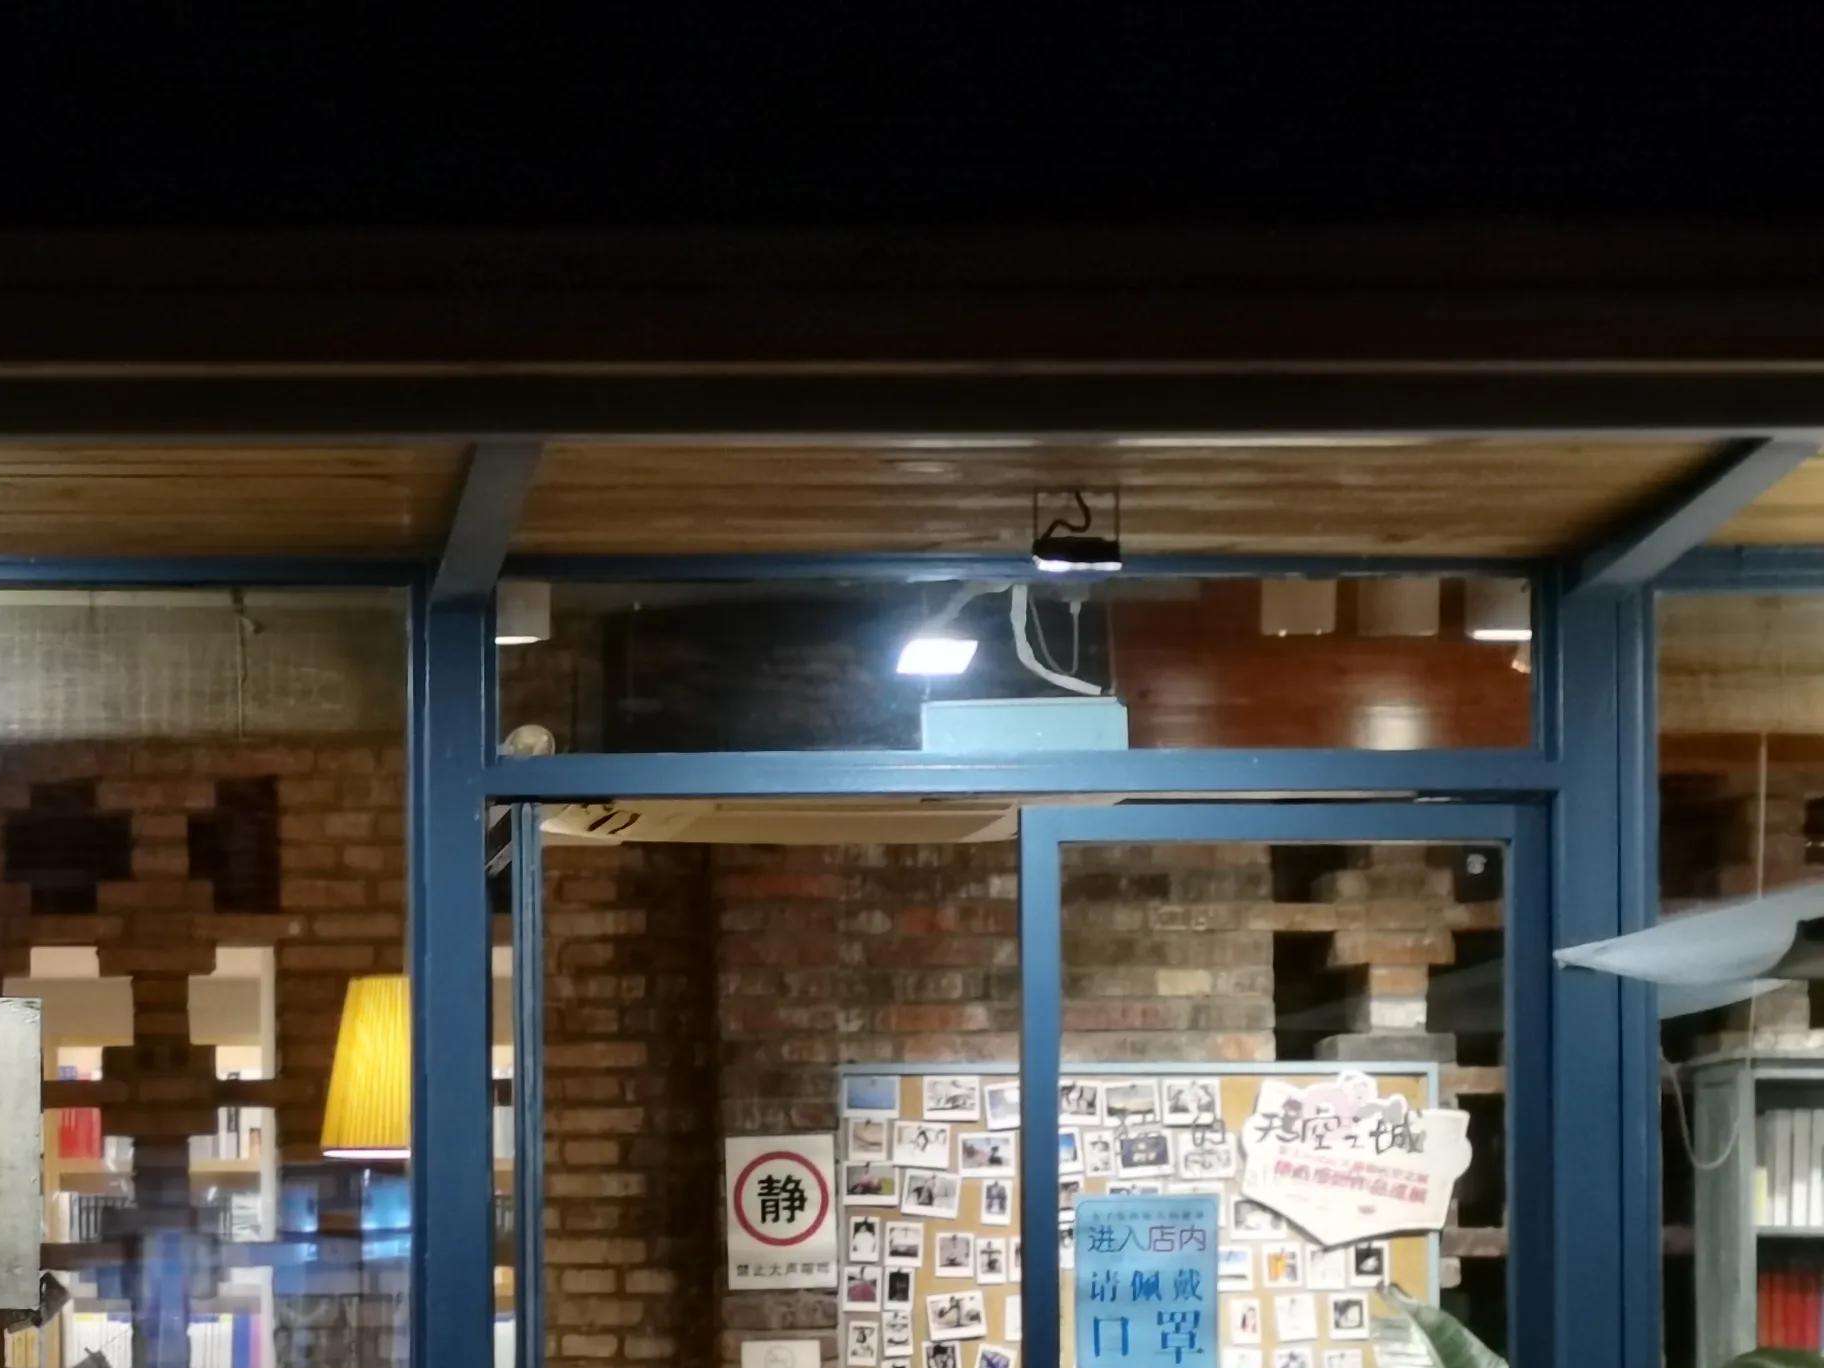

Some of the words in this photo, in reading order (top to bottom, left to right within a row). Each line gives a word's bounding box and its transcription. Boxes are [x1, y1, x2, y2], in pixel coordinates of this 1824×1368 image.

[757, 1174, 807, 1224] 静
[1088, 1225, 1206, 1253] 进入店内
[1090, 1269, 1203, 1302] 请佩戴
[1093, 1310, 1205, 1364] 口罩
